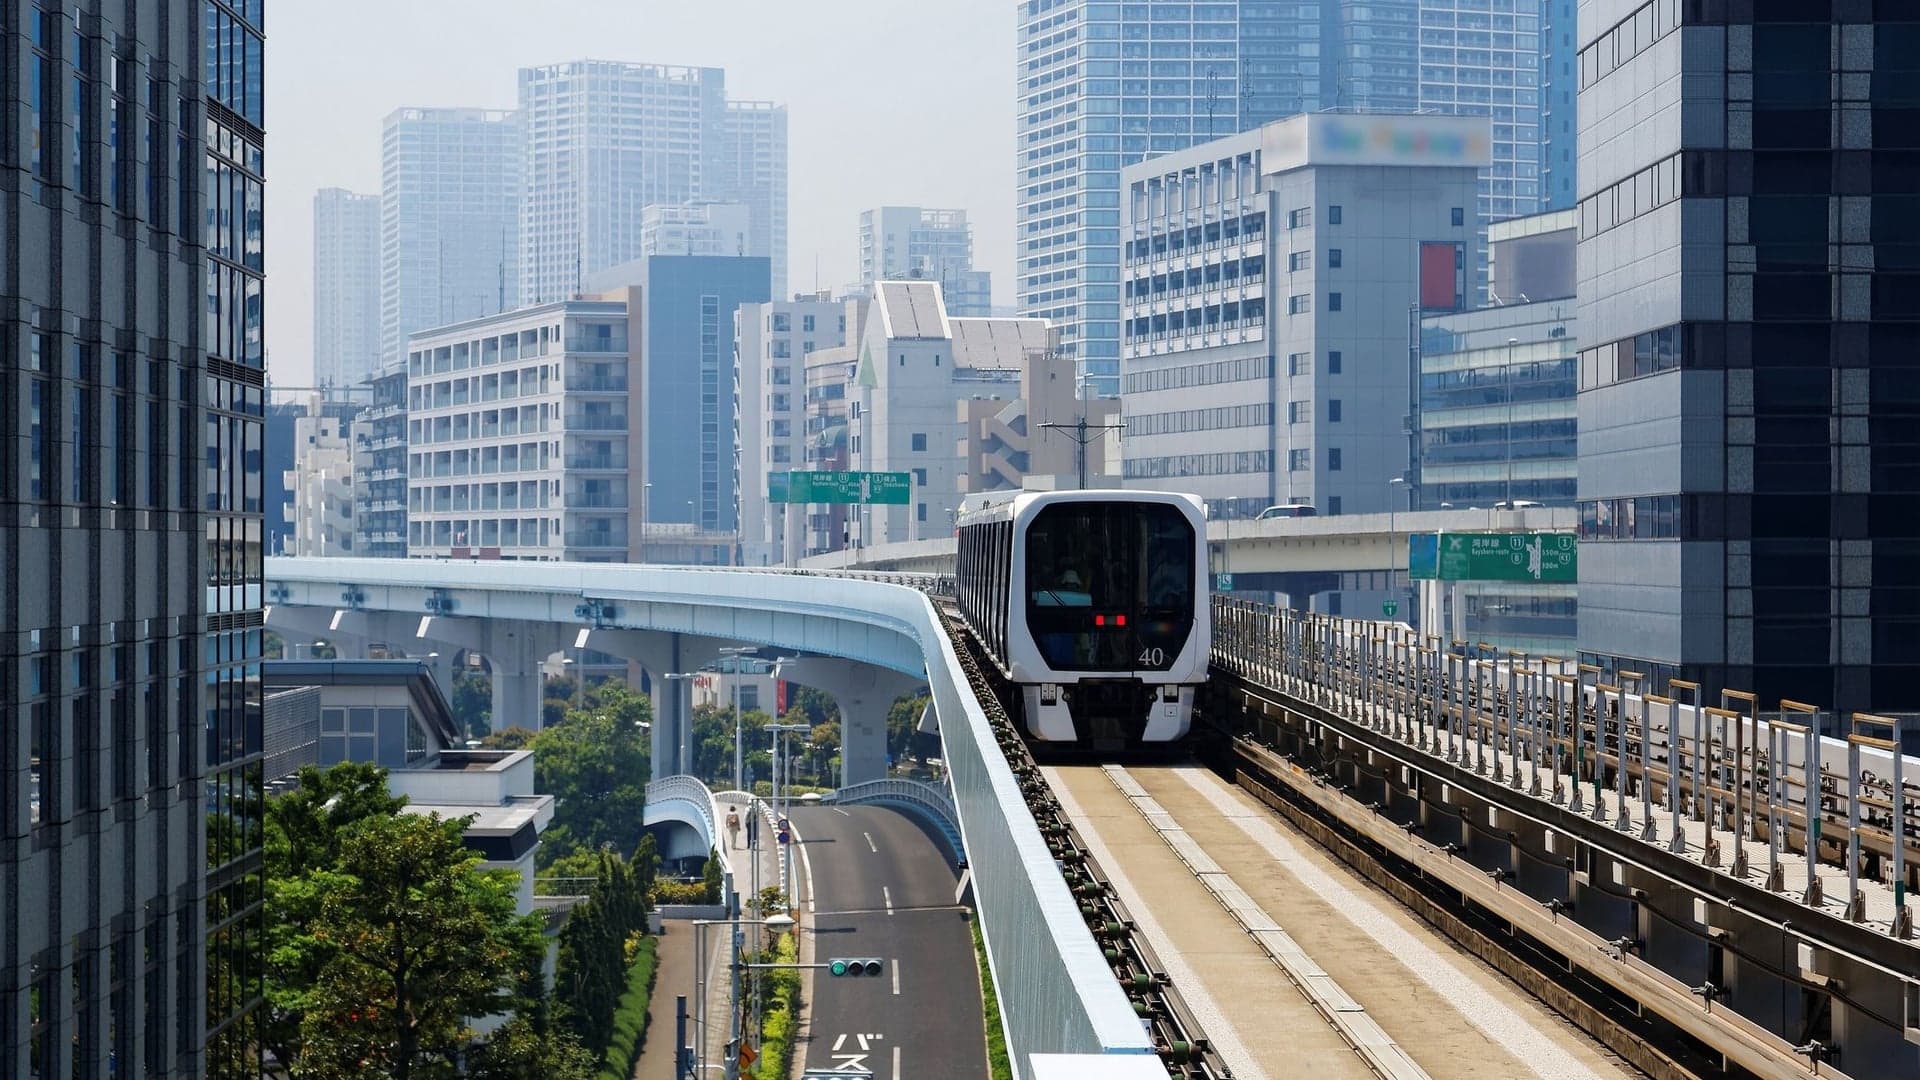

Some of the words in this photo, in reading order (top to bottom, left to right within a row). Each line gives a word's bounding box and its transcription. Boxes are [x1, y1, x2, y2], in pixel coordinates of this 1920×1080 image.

[1513, 538, 1521, 547] 11
[1138, 647, 1164, 666] 40
[831, 1033, 884, 1071] バス
